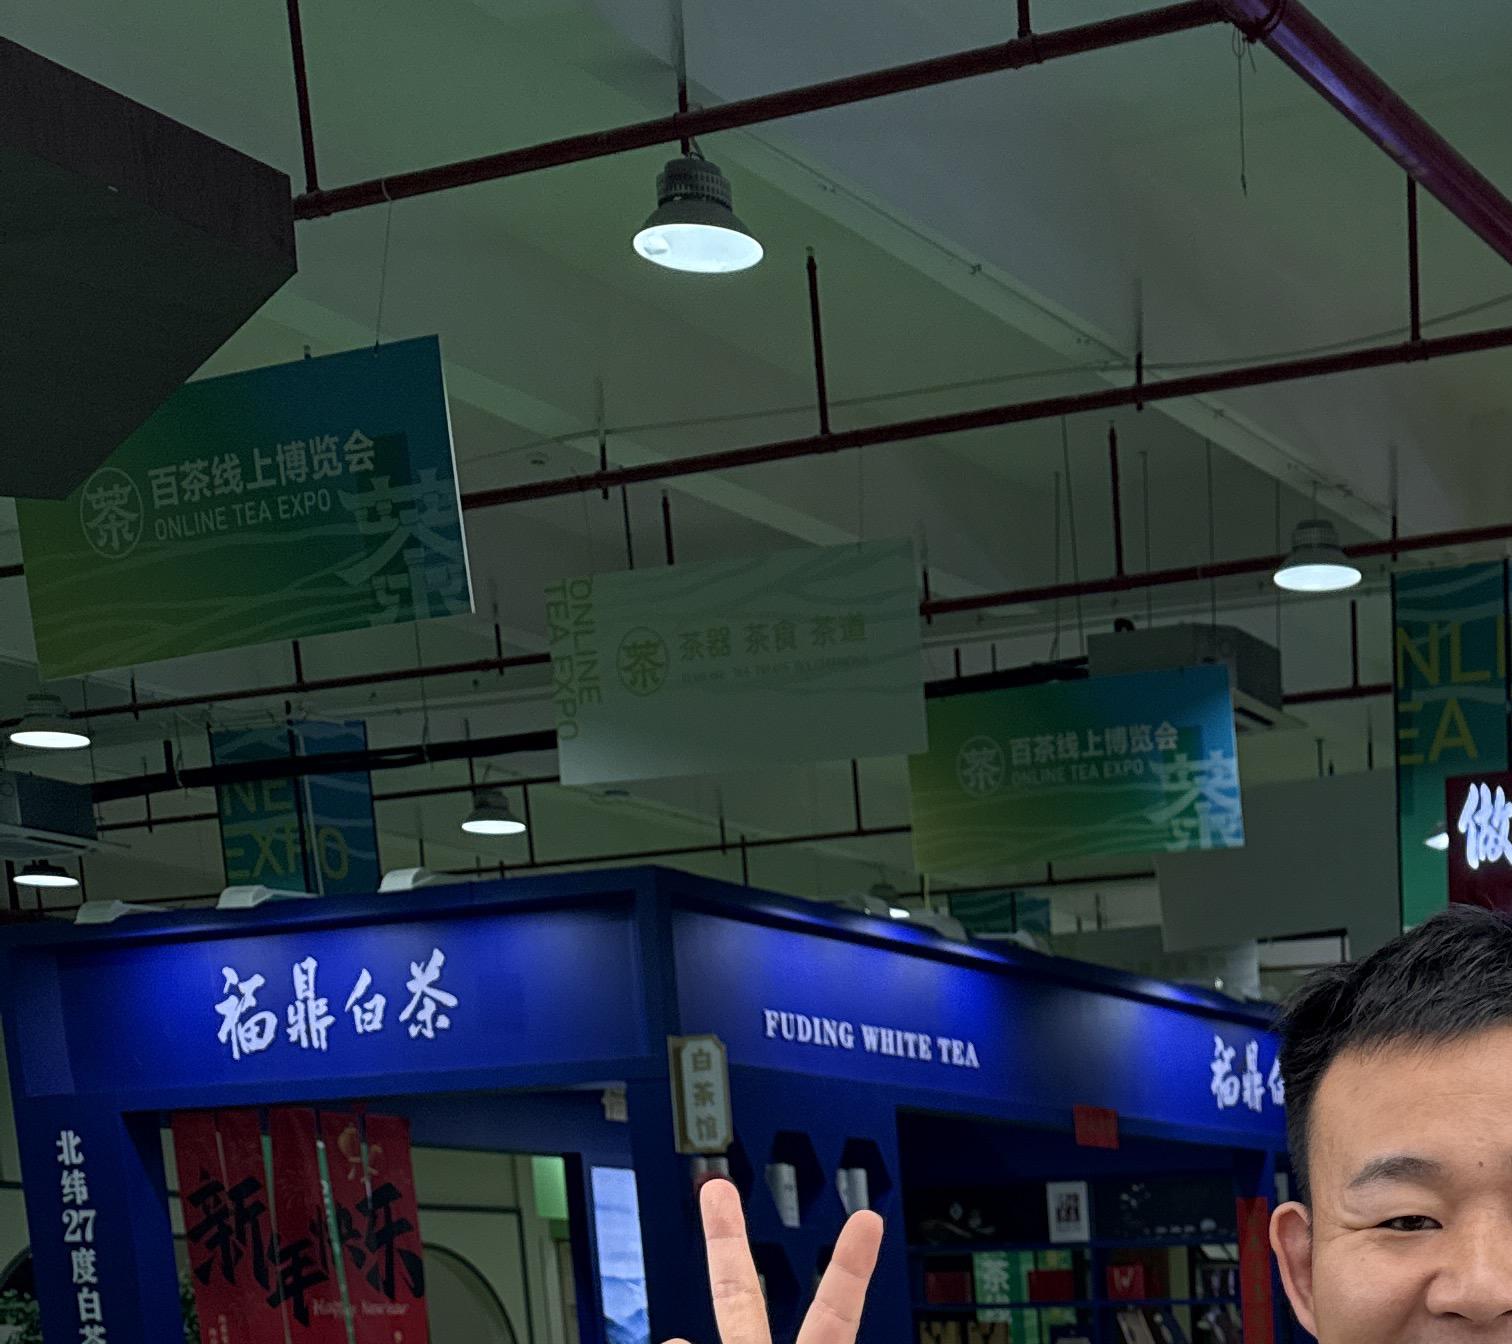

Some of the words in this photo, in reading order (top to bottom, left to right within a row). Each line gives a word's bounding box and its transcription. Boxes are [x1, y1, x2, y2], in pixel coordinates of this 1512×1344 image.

[147, 429, 375, 511] 百茶线上博览会
[154, 508, 228, 541] ONLINE
[232, 500, 272, 528] TEA
[278, 488, 332, 520] EXPO
[544, 586, 570, 646] TEA
[570, 576, 603, 705] ONLINE
[552, 655, 579, 741] EXPO
[1008, 720, 1179, 767] 百茶线上博览会
[1011, 768, 1066, 786] ONLINE
[1070, 763, 1099, 780] TEA
[1103, 758, 1145, 778] EXPO
[216, 948, 460, 1060] 福鼎白茶
[764, 1008, 855, 1050] FUDING
[860, 1023, 933, 1062] WHITE
[937, 1037, 980, 1070] TEA
[187, 1167, 425, 1328] 新年快乐
